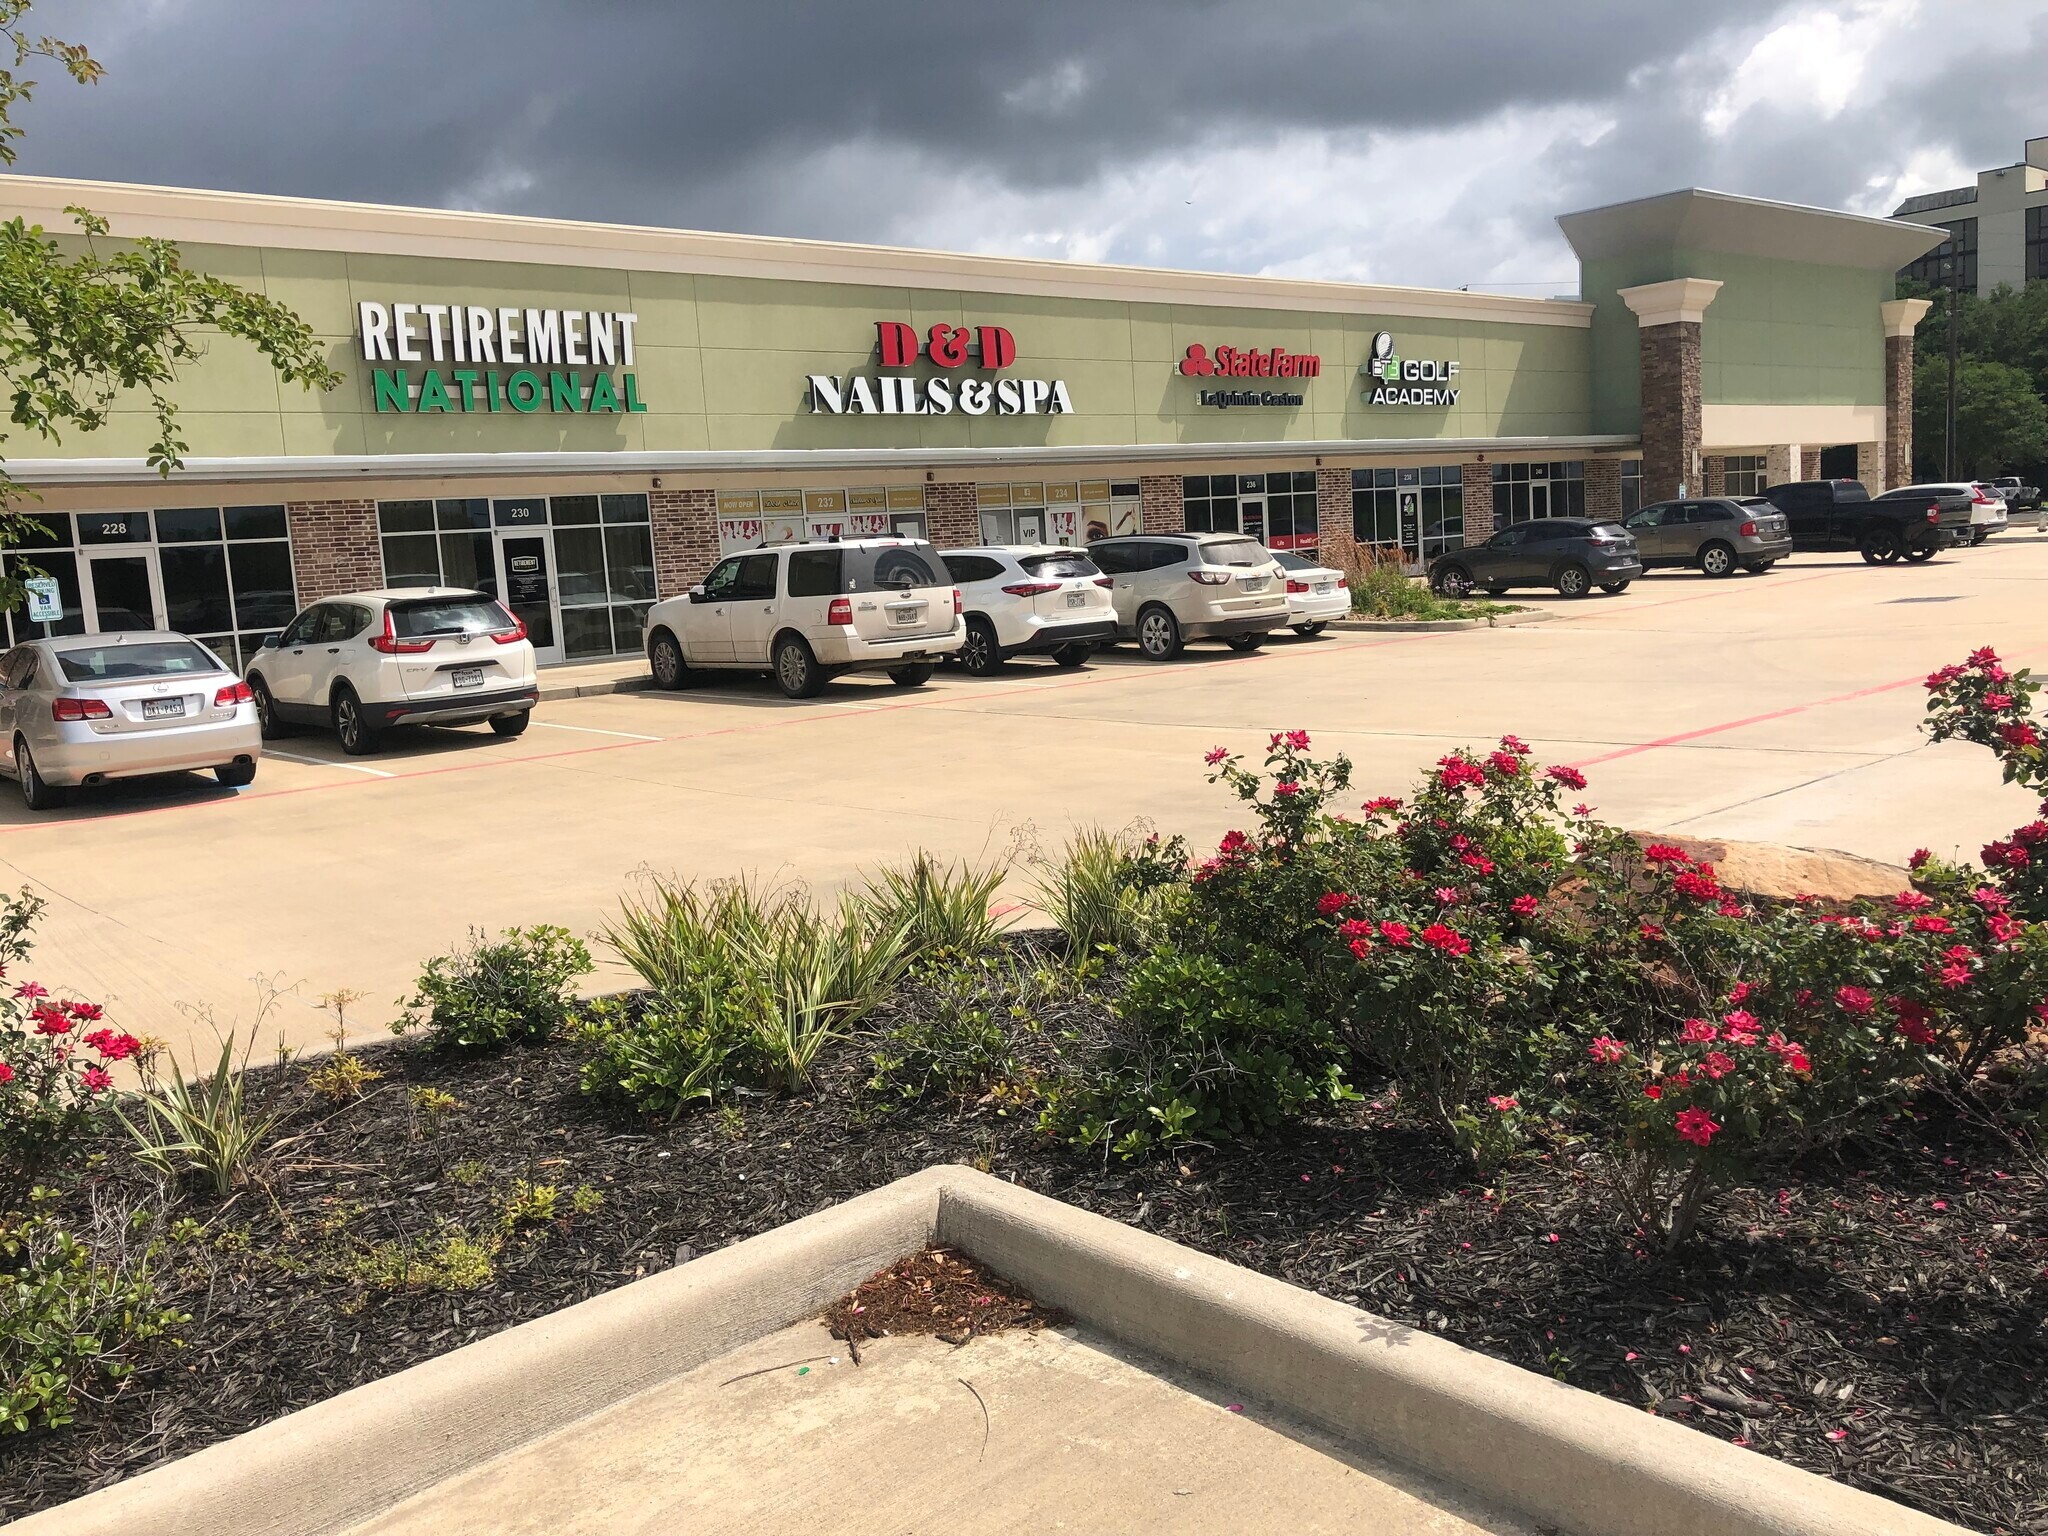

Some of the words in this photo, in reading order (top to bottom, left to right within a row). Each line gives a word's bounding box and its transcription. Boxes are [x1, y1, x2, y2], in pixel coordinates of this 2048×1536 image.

[358, 301, 638, 366] RETIREMENT
[874, 321, 1016, 369] D&D
[1402, 359, 1460, 382] GOLF
[372, 368, 648, 413] NATIONAL
[1369, 387, 1460, 406] ACADEMY
[1246, 481, 1256, 489] 236
[1055, 488, 1068, 498] 234
[723, 501, 738, 509] NOW
[738, 500, 754, 508] OPEN
[817, 497, 834, 508] 232
[511, 508, 530, 518] 230
[102, 522, 127, 535] 228
[1022, 528, 1037, 538] VIP
